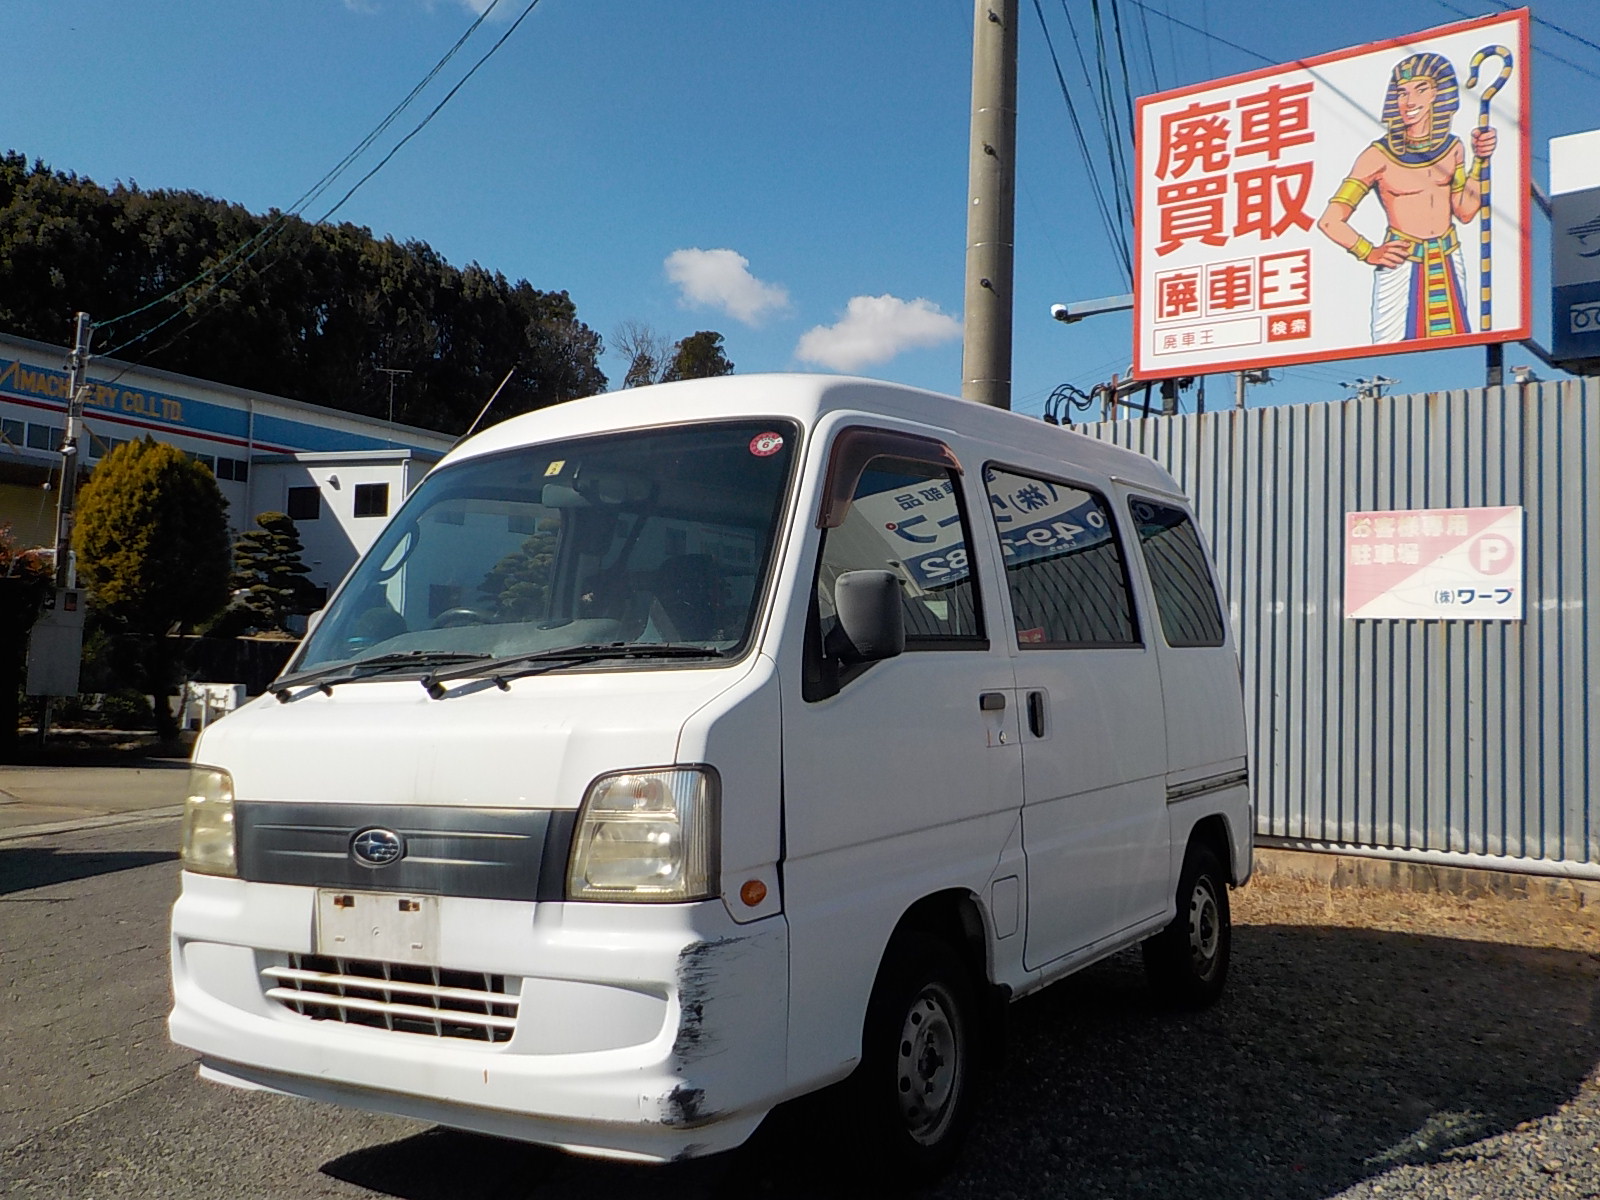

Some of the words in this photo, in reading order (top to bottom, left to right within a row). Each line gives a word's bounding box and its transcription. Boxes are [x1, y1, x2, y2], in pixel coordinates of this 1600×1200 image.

[1154, 81, 1315, 181] 廃車
[1154, 161, 1315, 257] 買取
[1156, 250, 1311, 319] 廃車王
[1163, 329, 1214, 349] 廃車王
[1271, 318, 1307, 336] 検索
[1479, 538, 1508, 572] P
